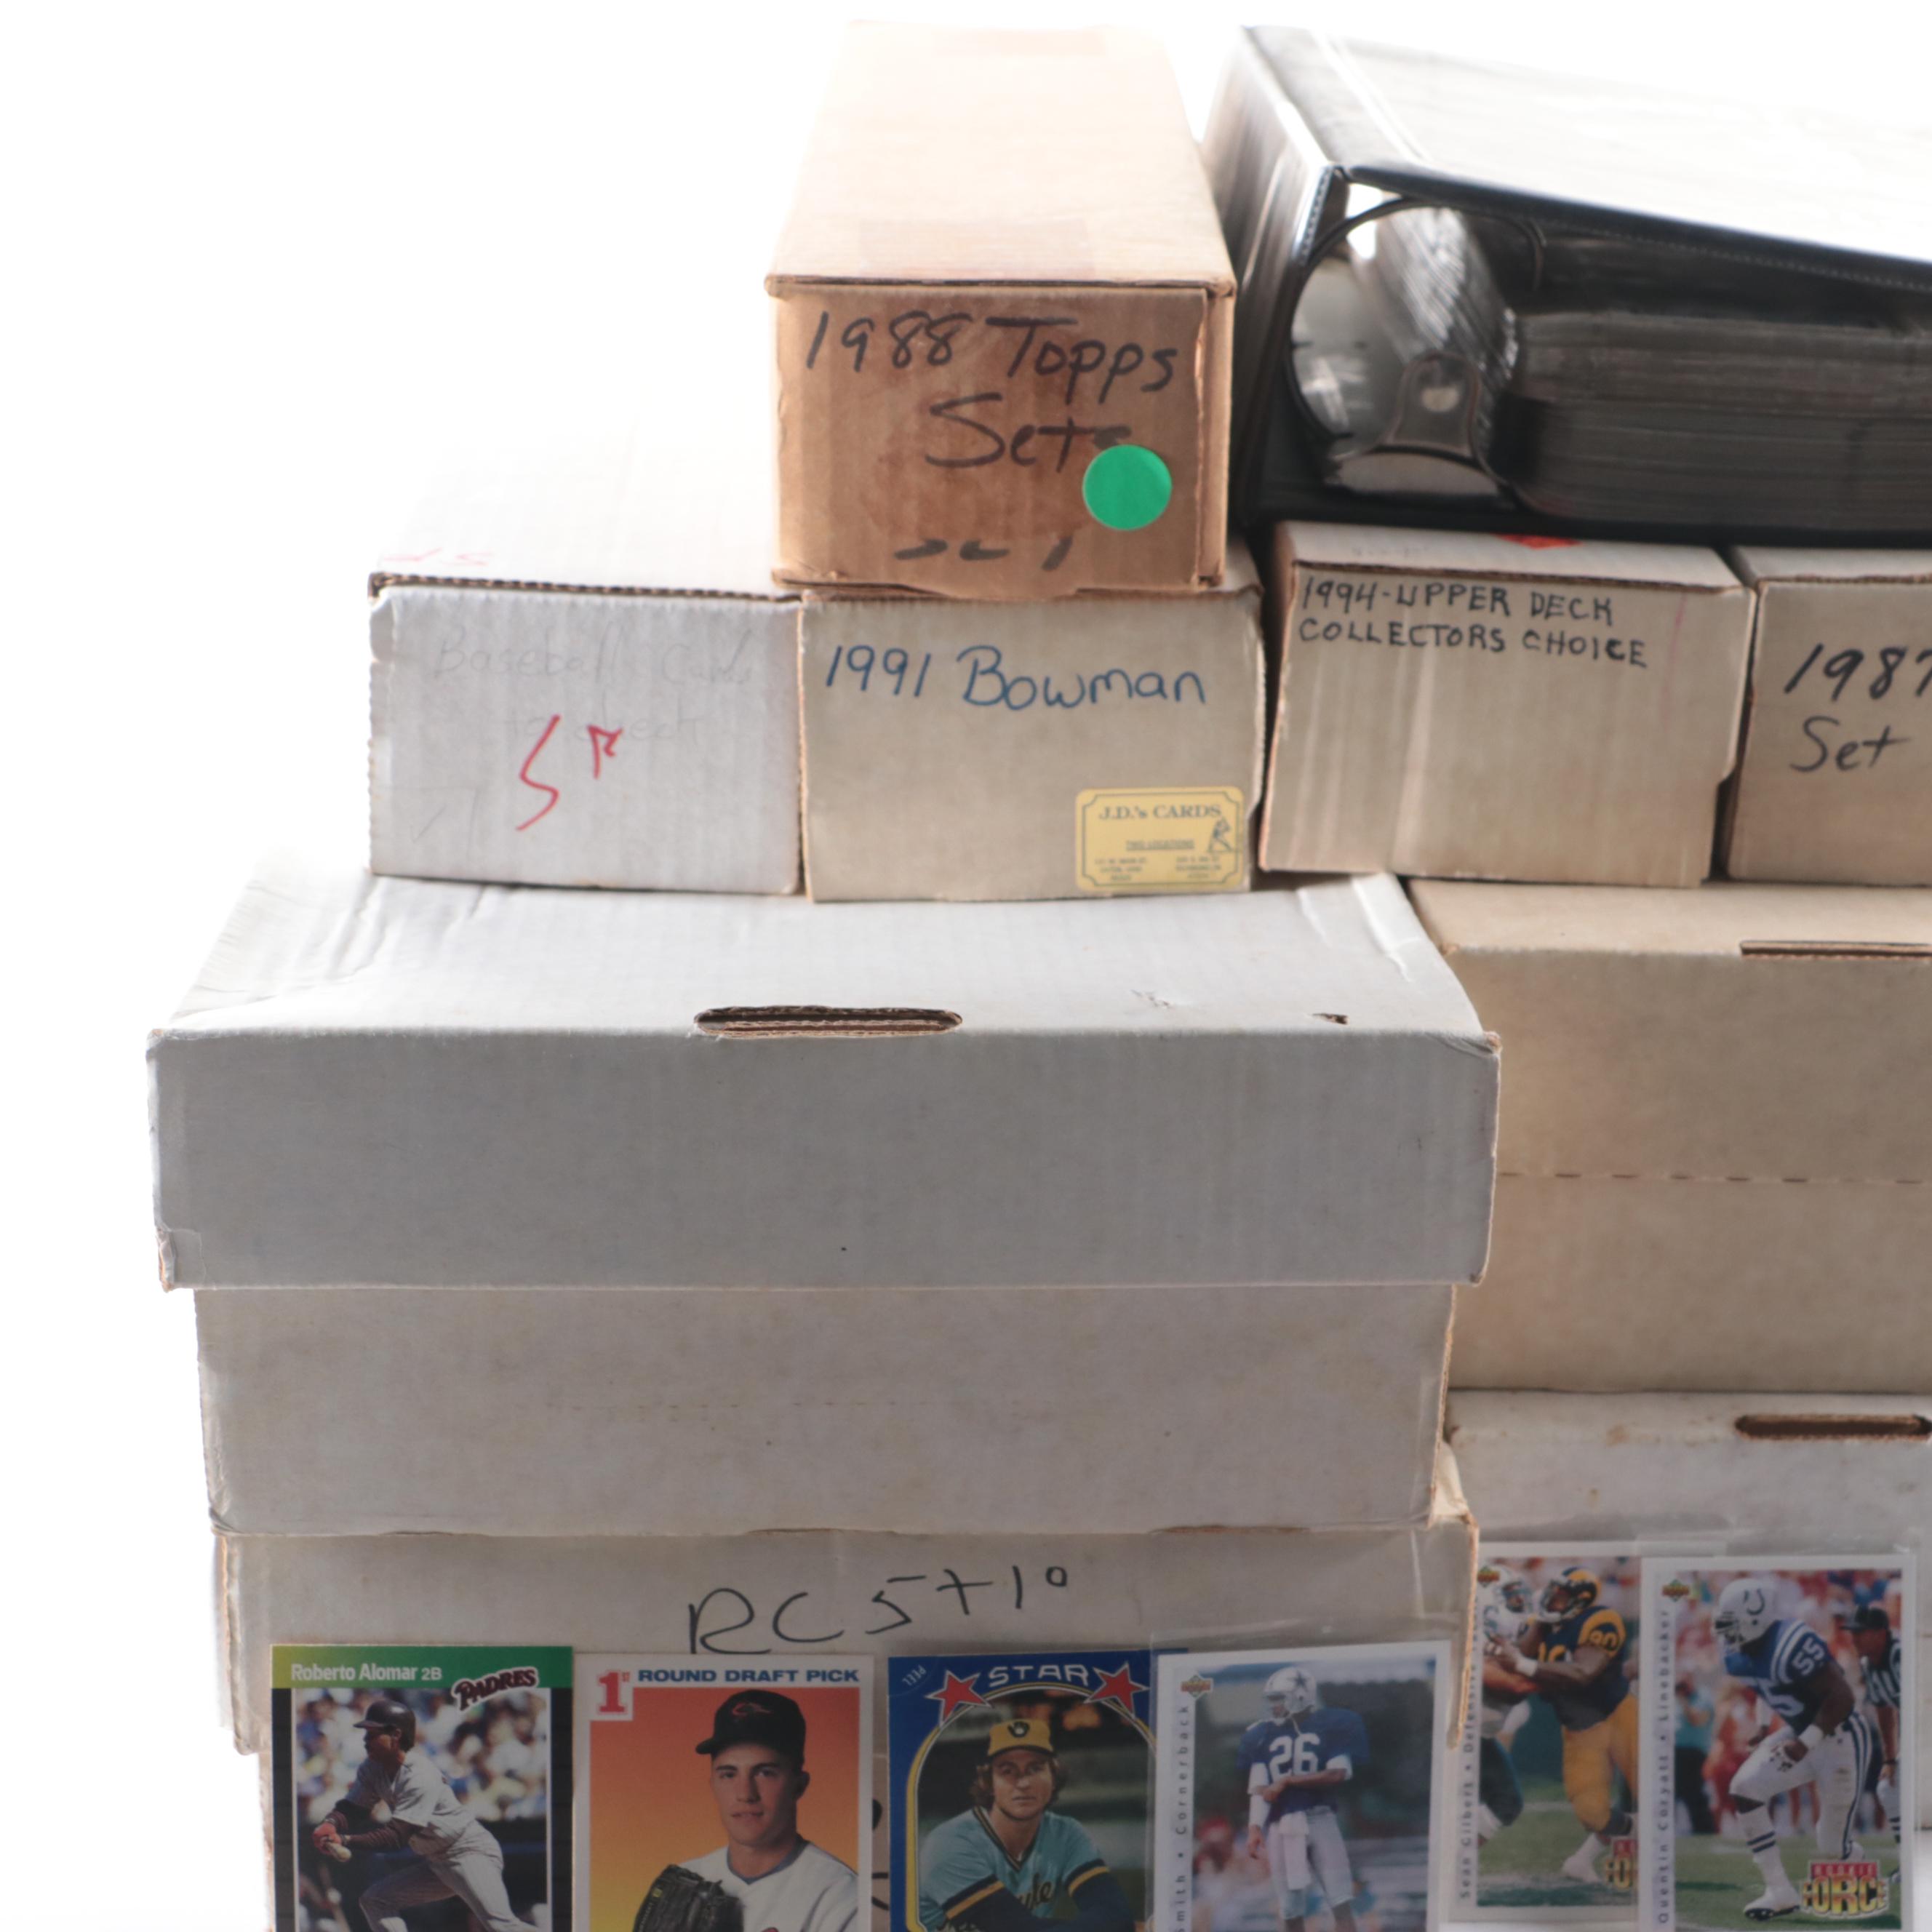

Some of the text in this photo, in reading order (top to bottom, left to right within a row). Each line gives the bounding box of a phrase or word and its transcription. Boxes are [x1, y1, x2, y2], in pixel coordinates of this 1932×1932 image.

[805, 311, 1178, 405] 1988 Topps
[1530, 591, 1613, 626] DECK
[1299, 618, 1647, 668] COLLECTORS CHOICE
[826, 644, 1207, 711] 1991 Bowman
[1789, 715, 1912, 773] Set
[1153, 804, 1222, 818] CARDS
[292, 1663, 443, 1681] Roberto Alomar 2B
[453, 1667, 539, 1712] PADRES
[638, 1669, 716, 1682] ROUND
[724, 1669, 799, 1682] DRAFT
[805, 1669, 860, 1682] PICK
[988, 1663, 1090, 1688] STAR
[1174, 1704, 1189, 1836] Cornerback
[1269, 1732, 1320, 1778] 26
[1656, 1609, 1671, 1924] Quentin Coryatt Linebacker
[1460, 1781, 1474, 1847] Gilbert
[1459, 1858, 1472, 1900] Sean
[1802, 1873, 1889, 1915] FORCE
